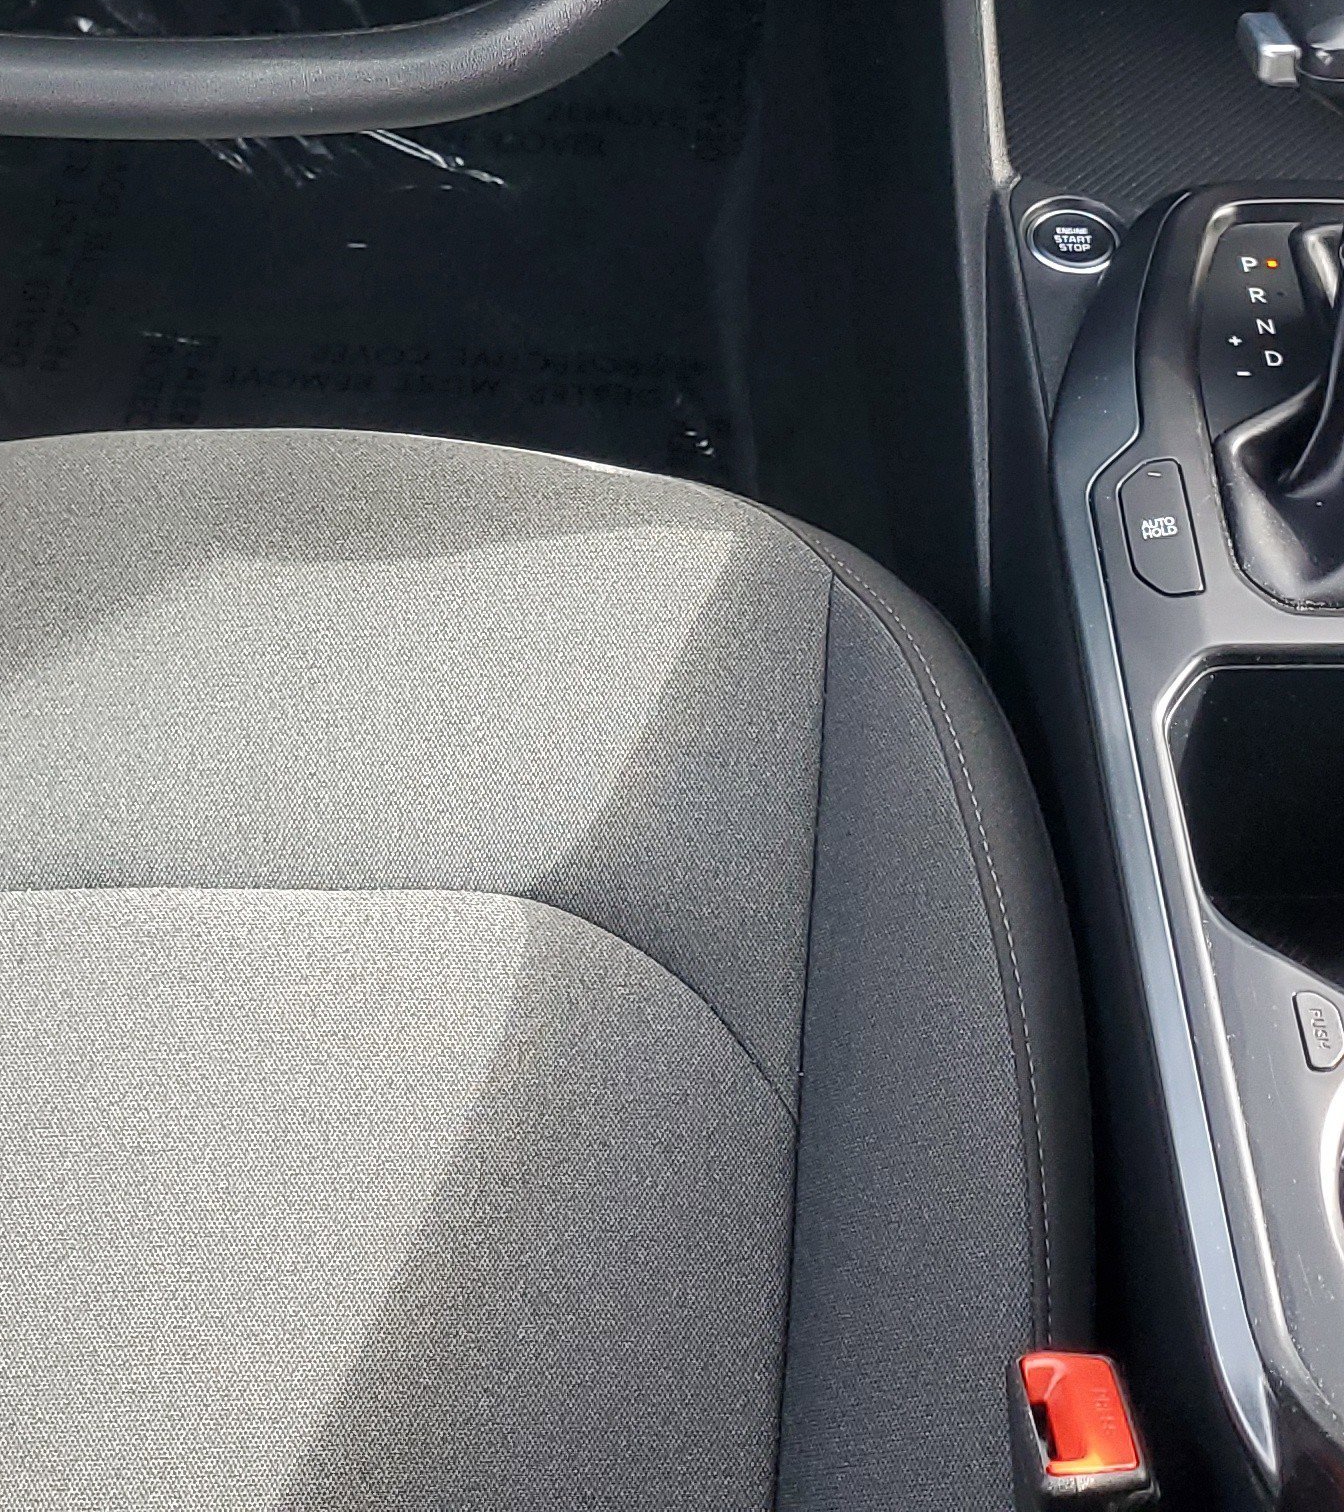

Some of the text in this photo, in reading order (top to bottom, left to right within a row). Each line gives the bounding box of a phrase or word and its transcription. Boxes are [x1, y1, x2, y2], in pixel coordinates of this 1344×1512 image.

[1053, 234, 1093, 244] START
[1058, 243, 1091, 252] STOP
[1240, 256, 1258, 273] P
[1248, 287, 1267, 304] R
[1255, 318, 1276, 335] N
[1264, 350, 1283, 367] D
[1141, 516, 1178, 531] AUTO
[1141, 525, 1178, 540] HOLD
